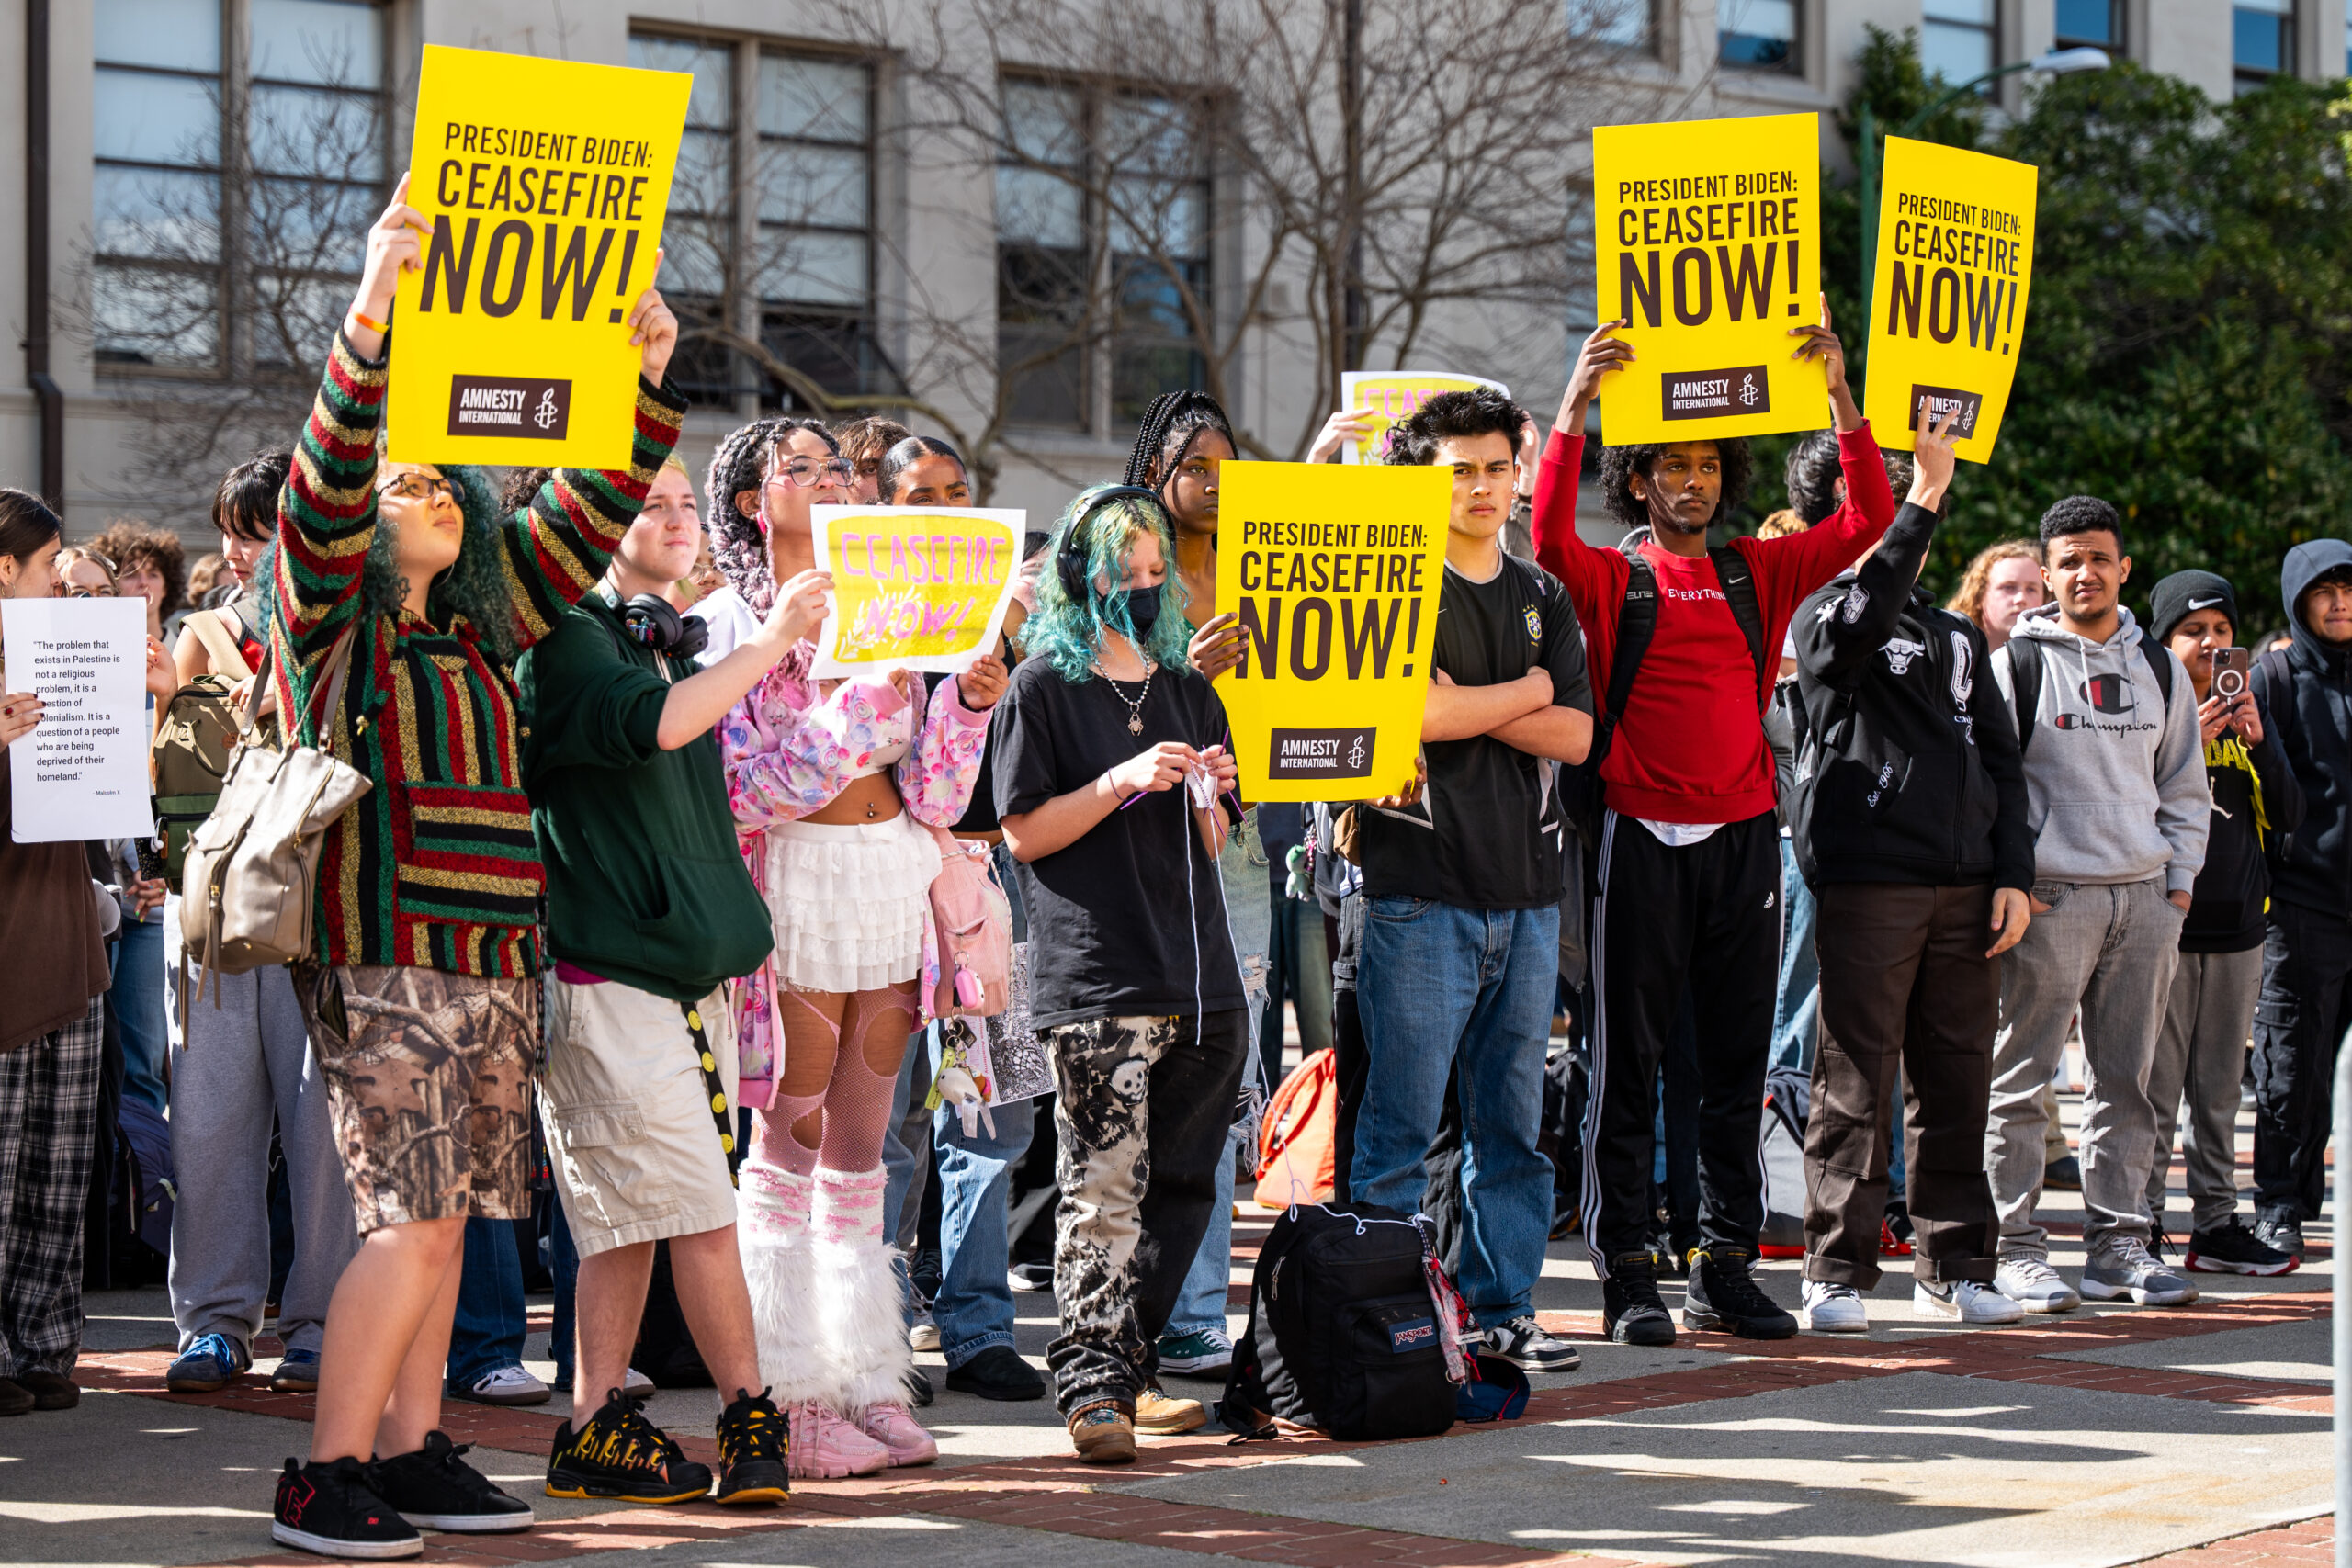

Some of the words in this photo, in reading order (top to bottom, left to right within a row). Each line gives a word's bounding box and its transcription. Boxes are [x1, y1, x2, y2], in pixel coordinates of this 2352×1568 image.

[445, 121, 578, 162] PRESIDENT
[582, 136, 653, 168] BIDEN:
[437, 158, 649, 221] CEASEFIRE
[1619, 175, 1729, 204] PRESIDENT
[1736, 170, 1798, 196] BIDEN:
[1618, 197, 1799, 247] CEASEFIRE
[1898, 192, 1978, 227] PRESIDENT
[1981, 208, 2021, 237] BIDEN:
[1894, 220, 2020, 277] CEASEFIRE
[419, 214, 639, 323] NOW!
[1619, 239, 1800, 329] NOW!
[1887, 260, 2018, 356] NOW!
[459, 387, 526, 411] AMNESTY
[1672, 378, 1730, 399] AMNESTY
[1672, 396, 1730, 411] INTERNATIONAL
[458, 410, 523, 425] INTERNATIONAL
[1243, 520, 1361, 547] PRESIDENT
[1366, 524, 1428, 548] BIDEN:
[841, 533, 1007, 585] CEASEFIRE
[1240, 550, 1427, 592] CEASEFIRE
[860, 597, 976, 642] NOW!
[56, 640, 91, 651] problem
[93, 640, 109, 649] that
[1234, 596, 1422, 682] NOW!
[34, 655, 61, 664] exists
[62, 655, 71, 664] in
[73, 654, 111, 664] Palestine
[113, 654, 120, 663] is
[35, 671, 50, 680] not
[59, 669, 96, 680] religious
[36, 684, 73, 694] problem,
[74, 684, 80, 693] it
[82, 684, 89, 693] is
[44, 698, 72, 708] estion
[74, 698, 83, 707] of
[40, 713, 86, 723] olonialism.
[87, 712, 95, 721] It
[96, 712, 104, 721] is
[105, 713, 111, 721] a
[2054, 712, 2158, 739] Chmpion
[36, 728, 73, 739] question
[74, 727, 83, 736] of
[91, 726, 120, 738] people
[36, 742, 54, 751] who
[55, 743, 69, 751] are
[71, 741, 95, 751] being
[1280, 739, 1340, 756] AMNESTY
[36, 756, 73, 768] deprived
[74, 755, 84, 765] of
[85, 755, 105, 764] their
[1280, 757, 1338, 769] INTERNATIONAL
[37, 771, 83, 782] homeland."
[1878, 761, 1894, 789] 1966
[1394, 1325, 1433, 1346] JANSPORT
